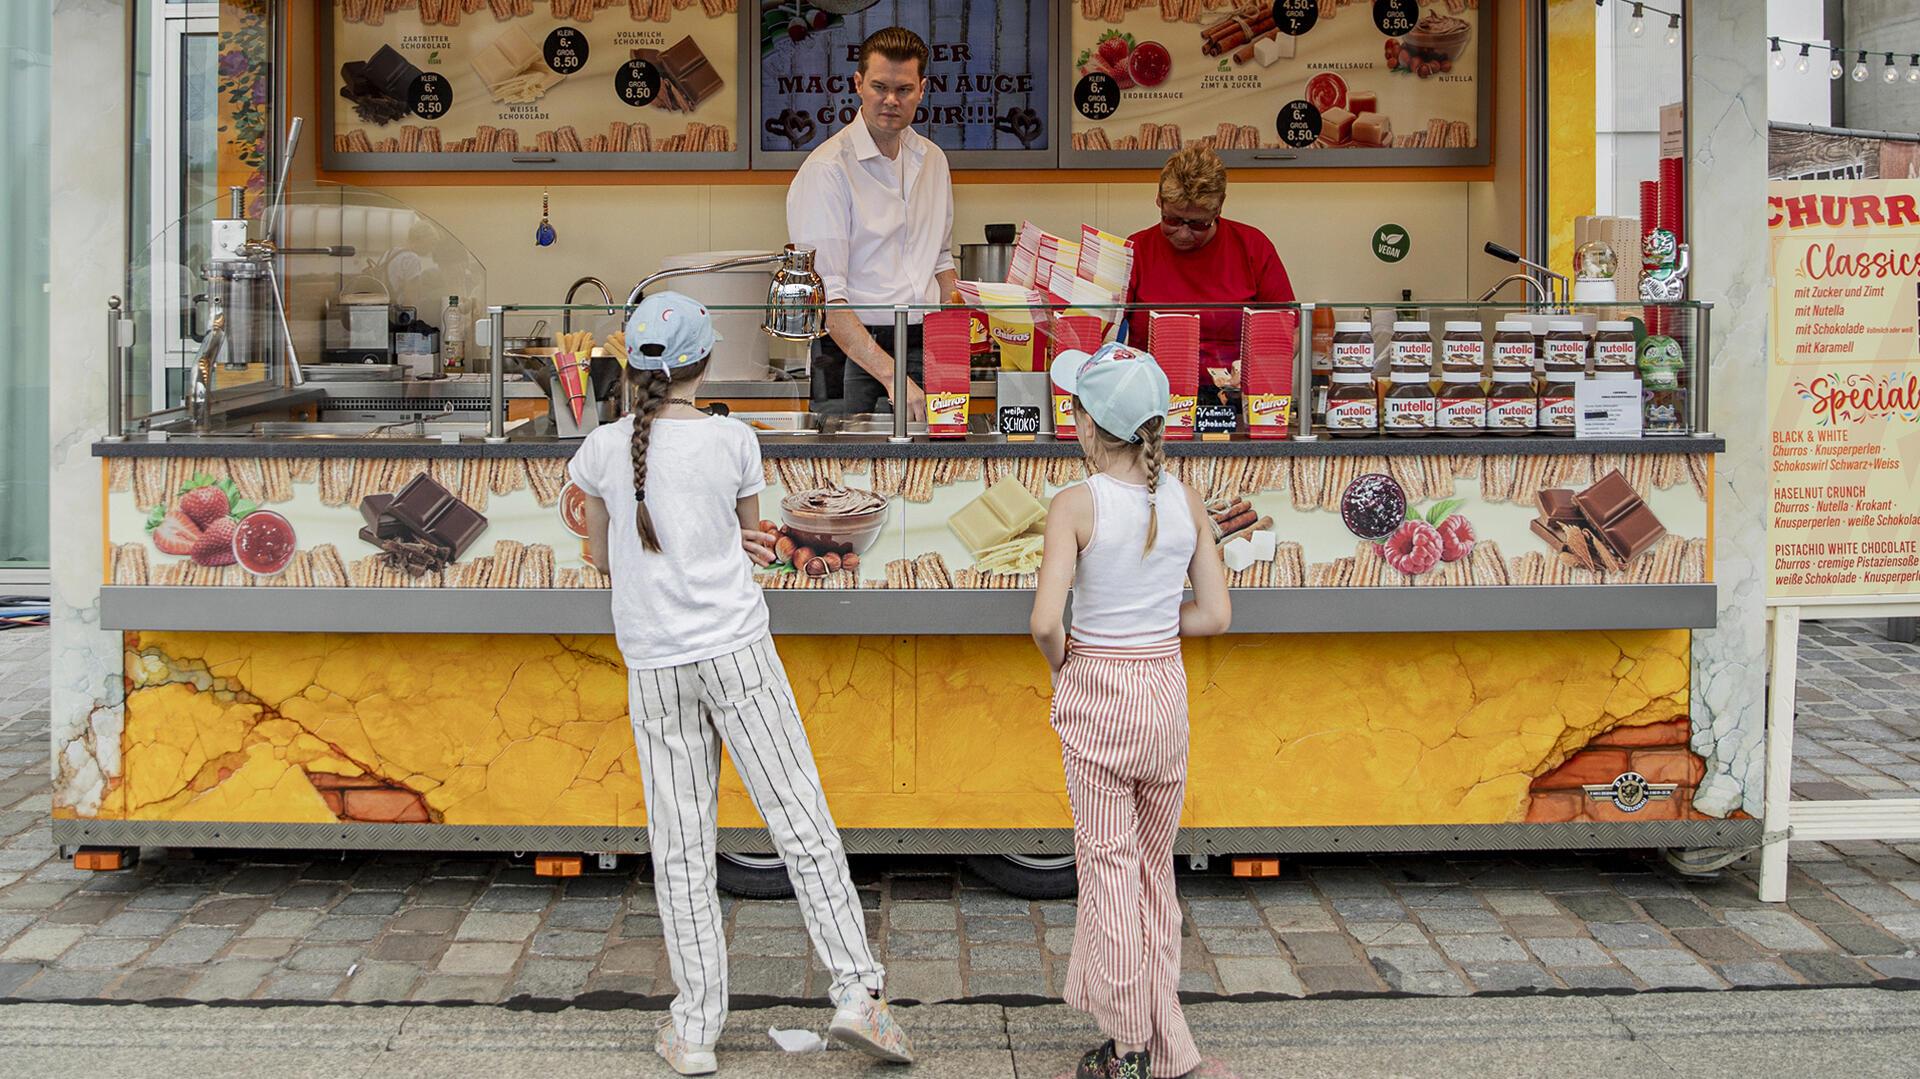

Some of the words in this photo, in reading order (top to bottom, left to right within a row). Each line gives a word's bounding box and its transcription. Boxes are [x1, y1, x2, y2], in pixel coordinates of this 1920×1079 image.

[553, 56, 578, 67] 8.50
[955, 75, 1032, 93] AUGE
[625, 88, 651, 98] 8.50
[417, 102, 442, 113] 8.50
[1378, 243, 1401, 258] VEGAN
[1794, 287, 1811, 298] mit
[1811, 286, 1843, 298] Zucker
[1844, 286, 1862, 297] und
[1863, 285, 1884, 297] Zimt
[1794, 305, 1811, 316] mit
[1812, 305, 1845, 316] Nutella
[993, 327, 1030, 342] Churros
[1795, 324, 1812, 335] mit
[1813, 323, 1864, 335] Schokolade
[1337, 345, 1371, 355] nutella
[1399, 343, 1431, 353] nutella
[1447, 343, 1481, 352] nutella
[1499, 345, 1533, 355] nutella
[1550, 343, 1584, 352] nutella
[1599, 343, 1633, 353] nutella
[1796, 342, 1812, 353] mit
[1813, 341, 1854, 353] Karamell
[930, 396, 966, 411] Churros
[1252, 397, 1288, 412] Churros
[1392, 400, 1434, 412] nutella
[1337, 405, 1371, 416] nutella
[1448, 405, 1482, 415] nutella
[1498, 406, 1533, 416] nutella
[1003, 417, 1036, 432] SCHOKO
[1772, 431, 1804, 443] BLACK
[1807, 430, 1814, 442] &
[1817, 429, 1849, 442] WHITE
[1772, 444, 1808, 457] Churros
[1815, 443, 1881, 457] Knusperperlen
[1773, 459, 1829, 472] Schokoswirl
[1829, 458, 1900, 471] Schwarz+Weiss
[1774, 487, 1824, 500] HASELNUT
[1826, 486, 1866, 498] CRUNCH
[1774, 501, 1809, 513] Churros
[1816, 500, 1849, 512] Nutella
[1855, 499, 1892, 511] Krokant
[1774, 516, 1840, 530] Knusperperlen
[1848, 515, 1875, 526] weiße
[1775, 543, 1825, 556] PISTACHIO
[1827, 542, 1858, 555] WHITE
[1861, 541, 1917, 554] CHOCOLATE
[1775, 558, 1810, 570] Churros
[1817, 557, 1854, 570] cremige
[1856, 555, 1919, 567] Pistaziensoße
[1775, 573, 1803, 585] weiße
[1804, 572, 1857, 585] Schokolade
